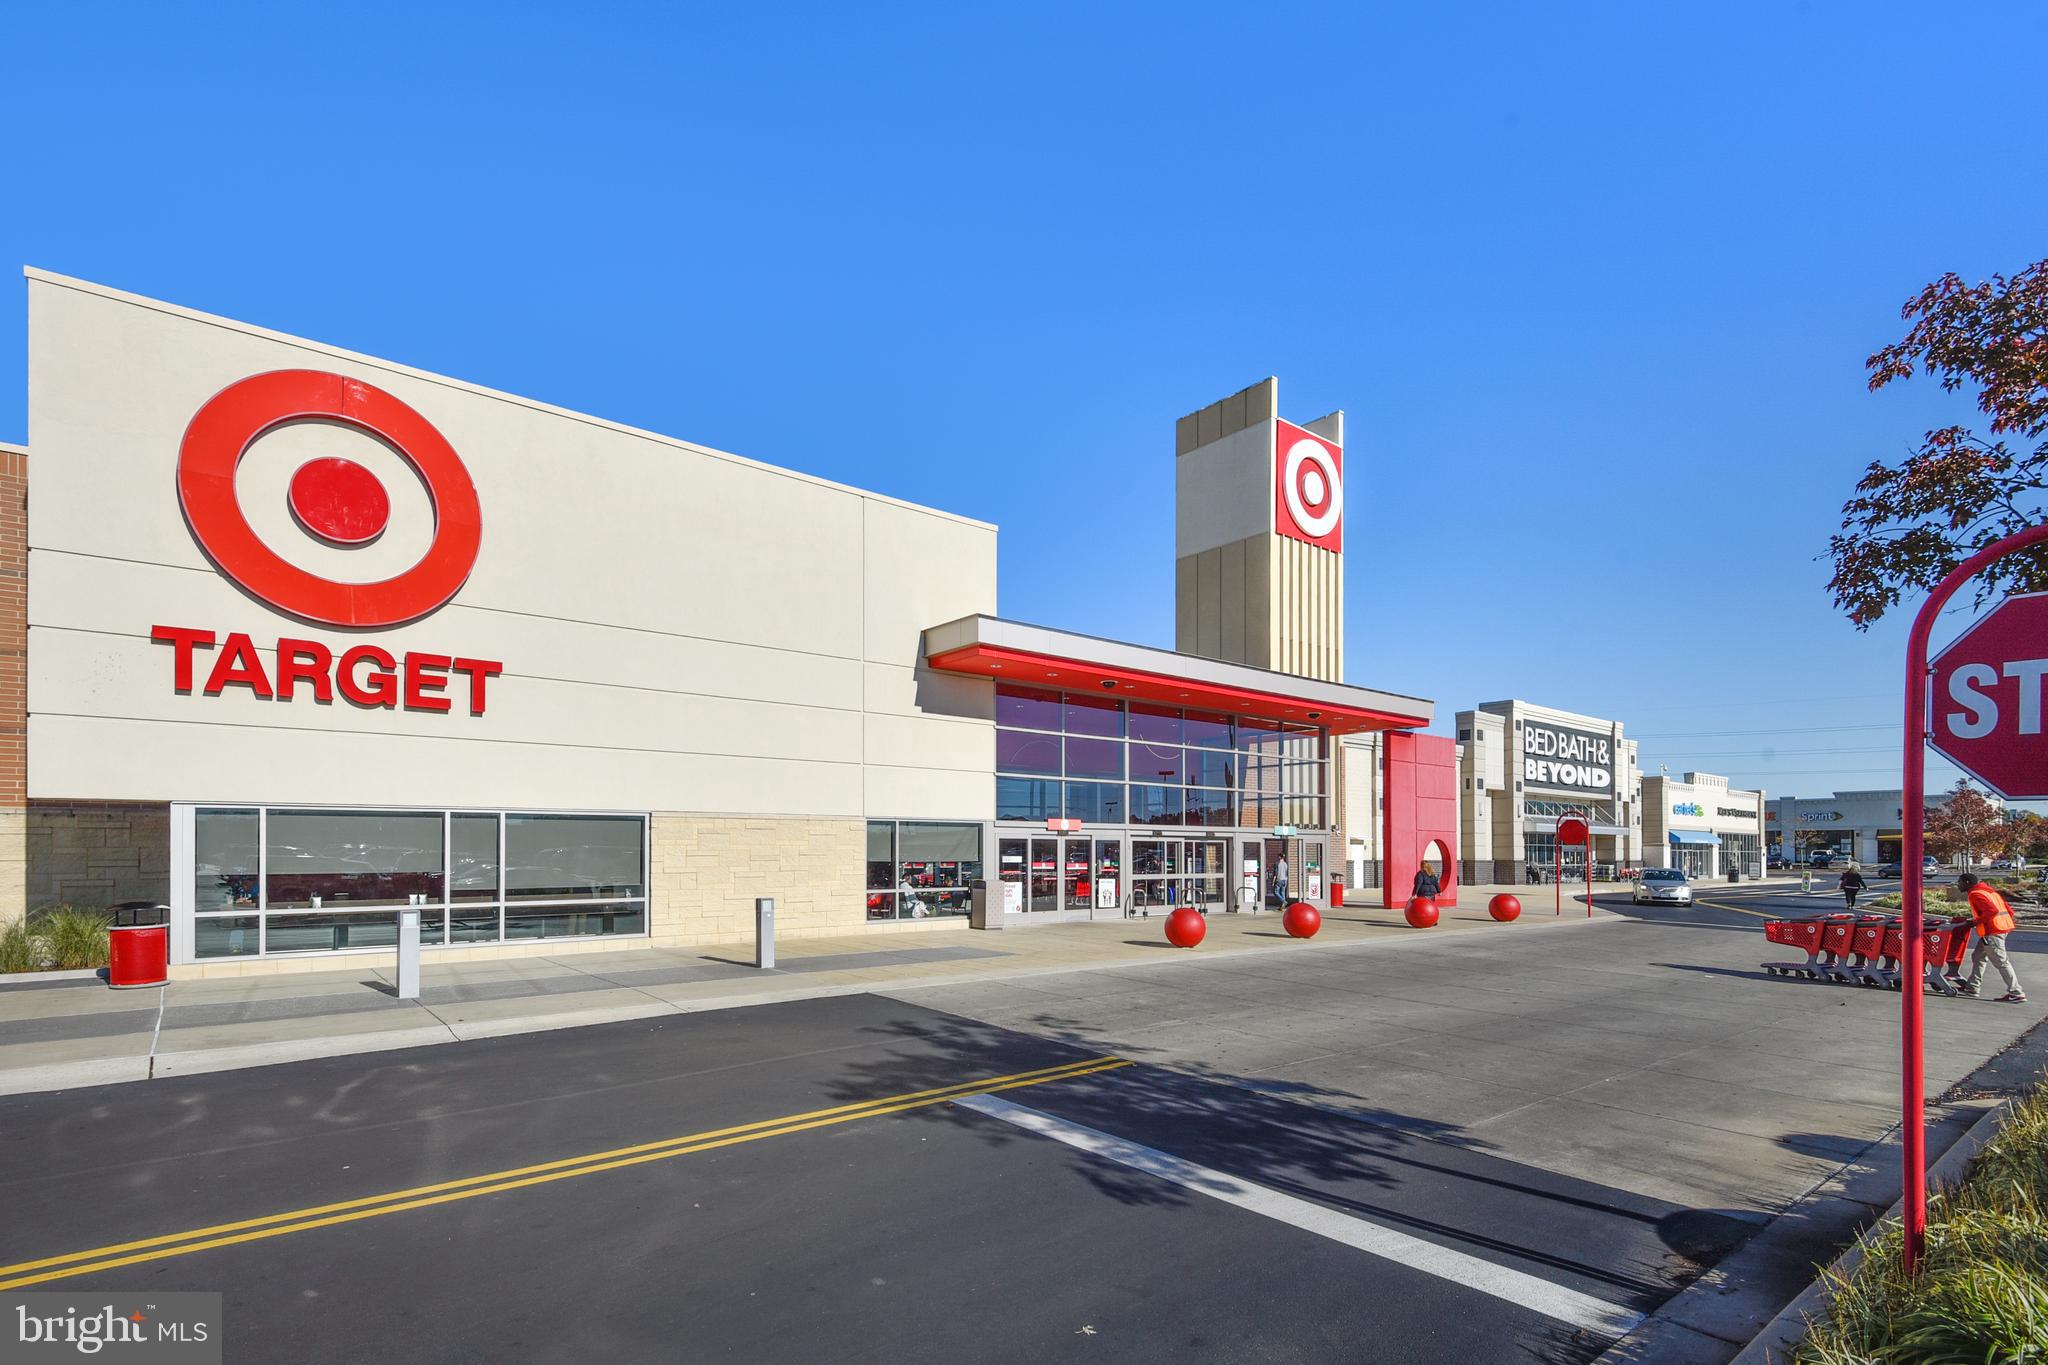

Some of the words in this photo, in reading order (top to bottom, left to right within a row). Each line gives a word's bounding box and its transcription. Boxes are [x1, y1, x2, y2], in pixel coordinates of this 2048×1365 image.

[151, 625, 503, 717] TARGET
[1946, 659, 2048, 739] ST
[1525, 726, 1558, 756] BED
[1558, 732, 1597, 763] BATH
[1597, 739, 1610, 765] &
[1525, 758, 1611, 788] BEYOND
[1801, 811, 1834, 823] Sprint
